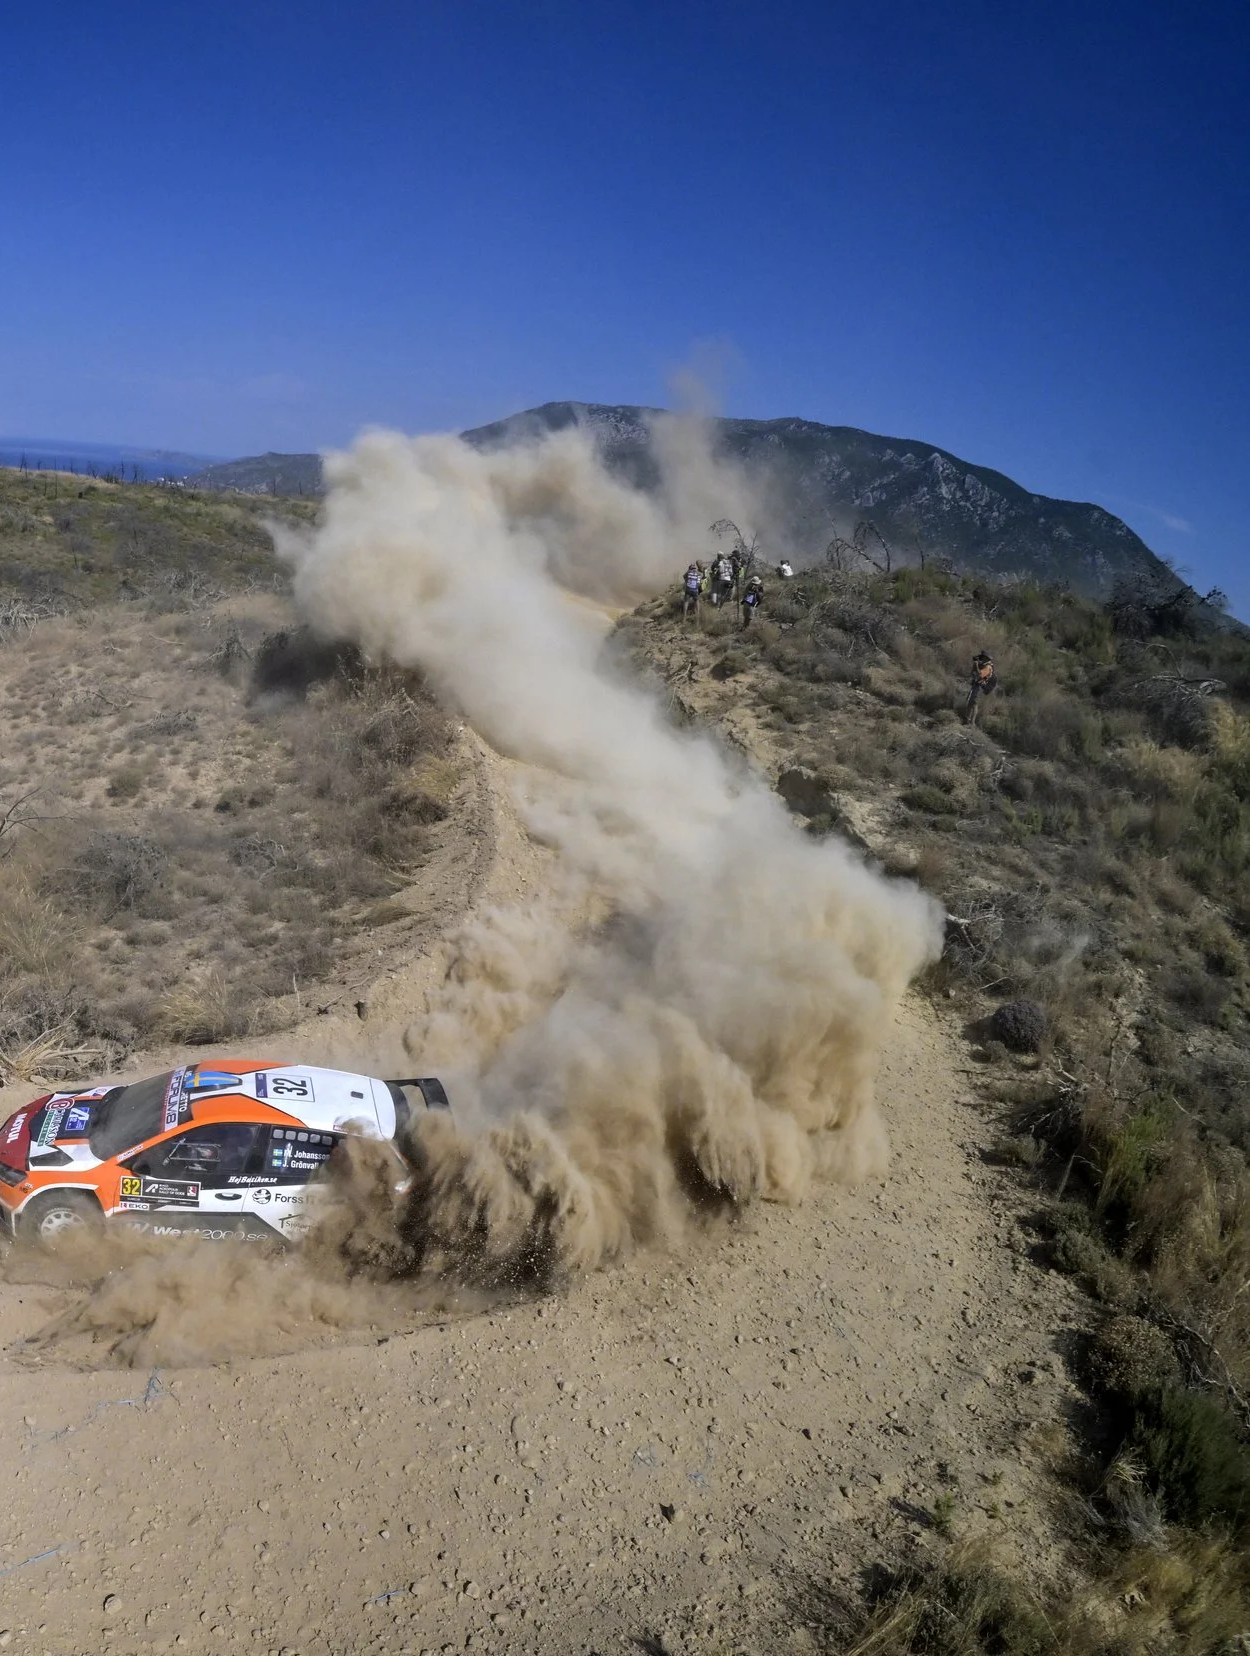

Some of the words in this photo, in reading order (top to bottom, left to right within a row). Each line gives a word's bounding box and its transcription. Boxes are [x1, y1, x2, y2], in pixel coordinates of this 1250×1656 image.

[272, 1078, 308, 1096] 32
[166, 1075, 182, 1124] FORUM8
[6, 1113, 27, 1144] MOTUL
[282, 1160, 289, 1168] J.
[122, 1178, 141, 1196] 32
[128, 1202, 149, 1210] EKO
[274, 1193, 304, 1204] Forss
